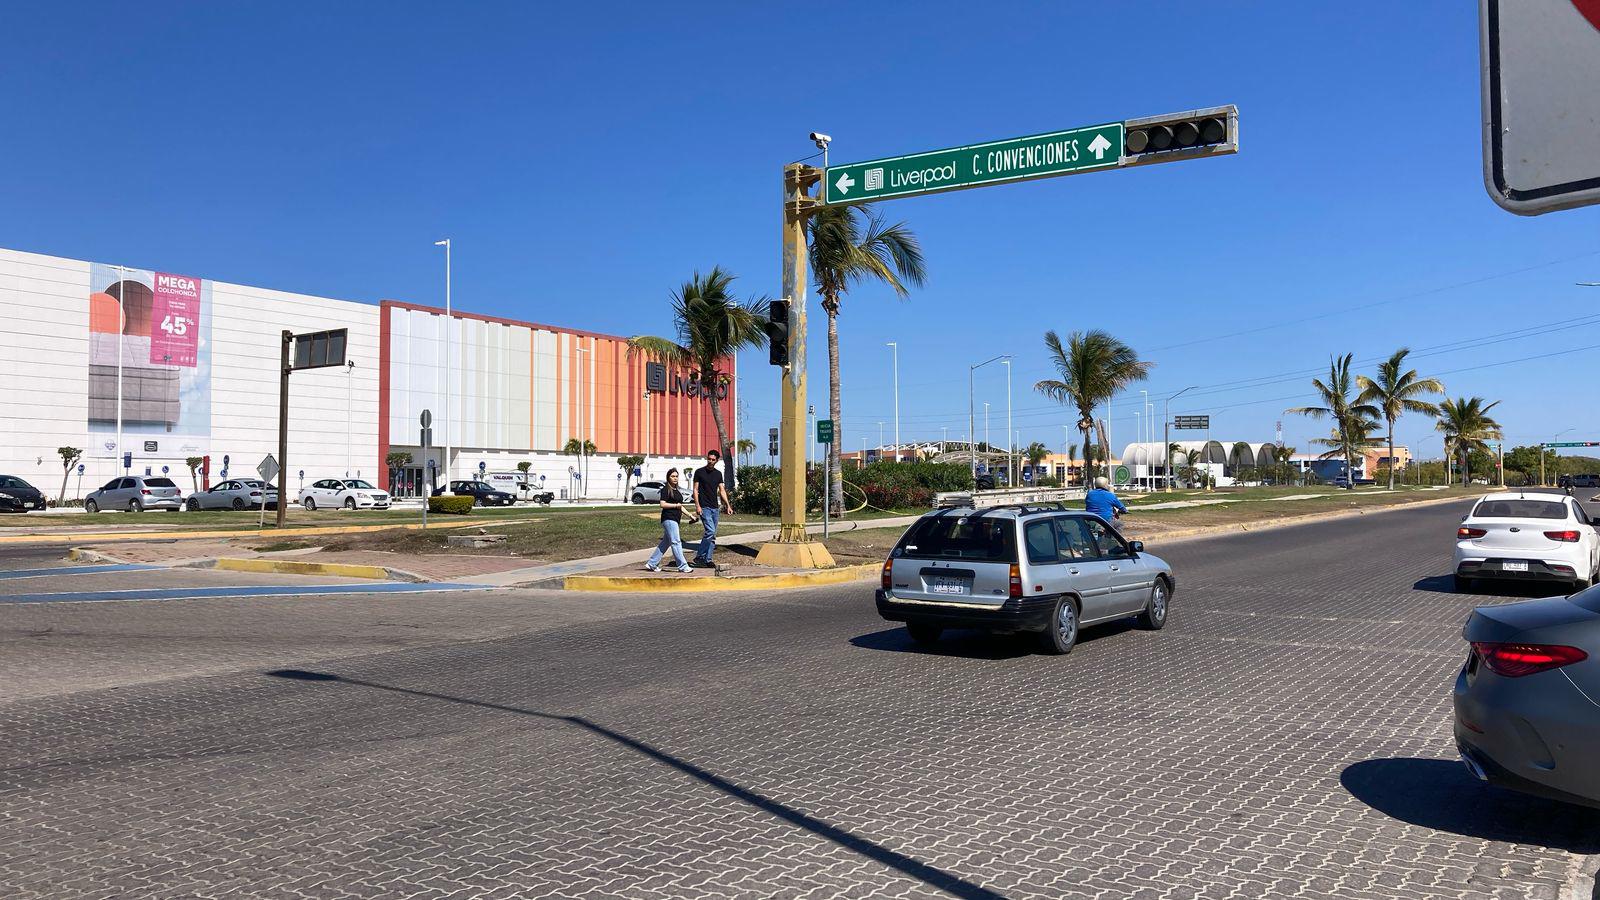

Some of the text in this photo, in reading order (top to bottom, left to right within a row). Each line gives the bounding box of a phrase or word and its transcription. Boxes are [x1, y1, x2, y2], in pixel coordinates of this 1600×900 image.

[972, 140, 1079, 175] C. CONVENCIONES
[890, 160, 957, 188] Liverpool
[158, 275, 196, 290] MEGA
[158, 287, 197, 297] COLCHONIZA
